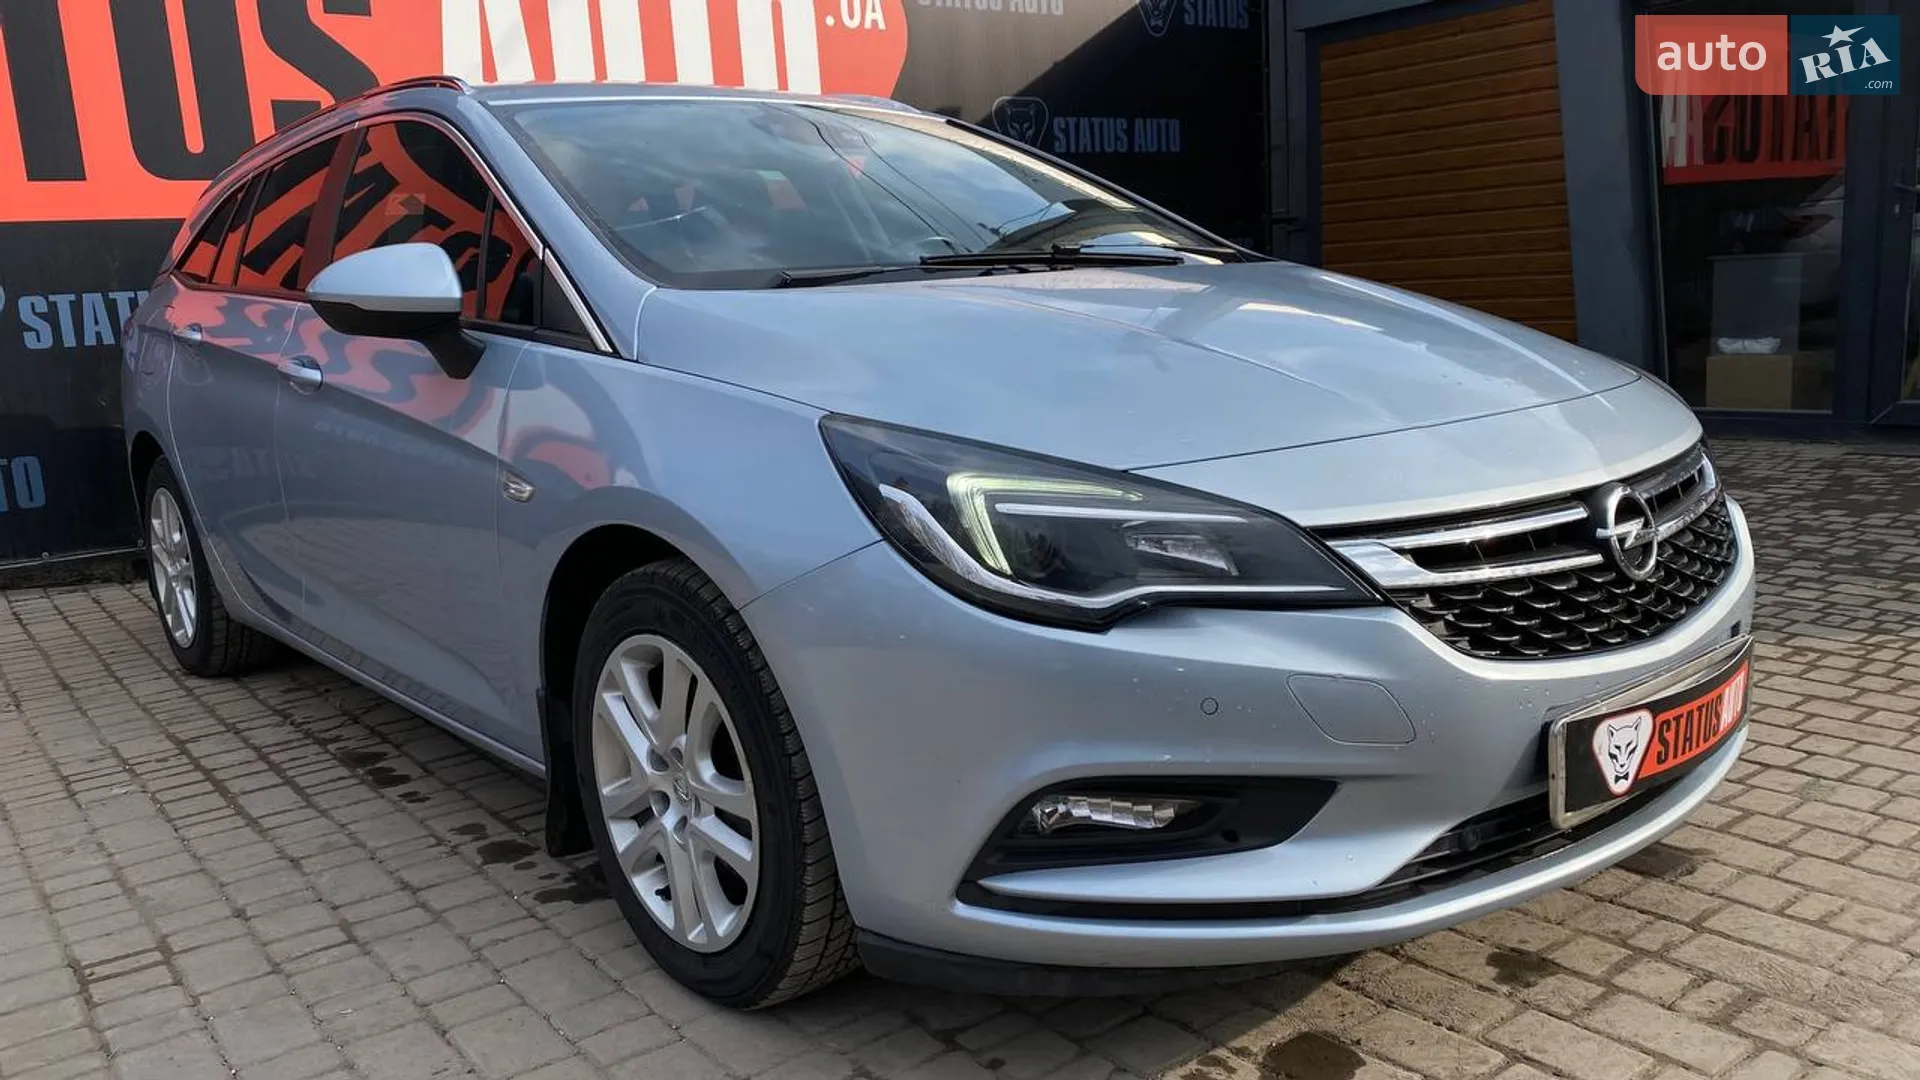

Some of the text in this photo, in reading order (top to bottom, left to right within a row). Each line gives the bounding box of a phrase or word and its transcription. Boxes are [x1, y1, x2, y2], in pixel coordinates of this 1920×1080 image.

[1053, 116, 1181, 153] STATUS AUTO
[18, 290, 149, 350] STAT
